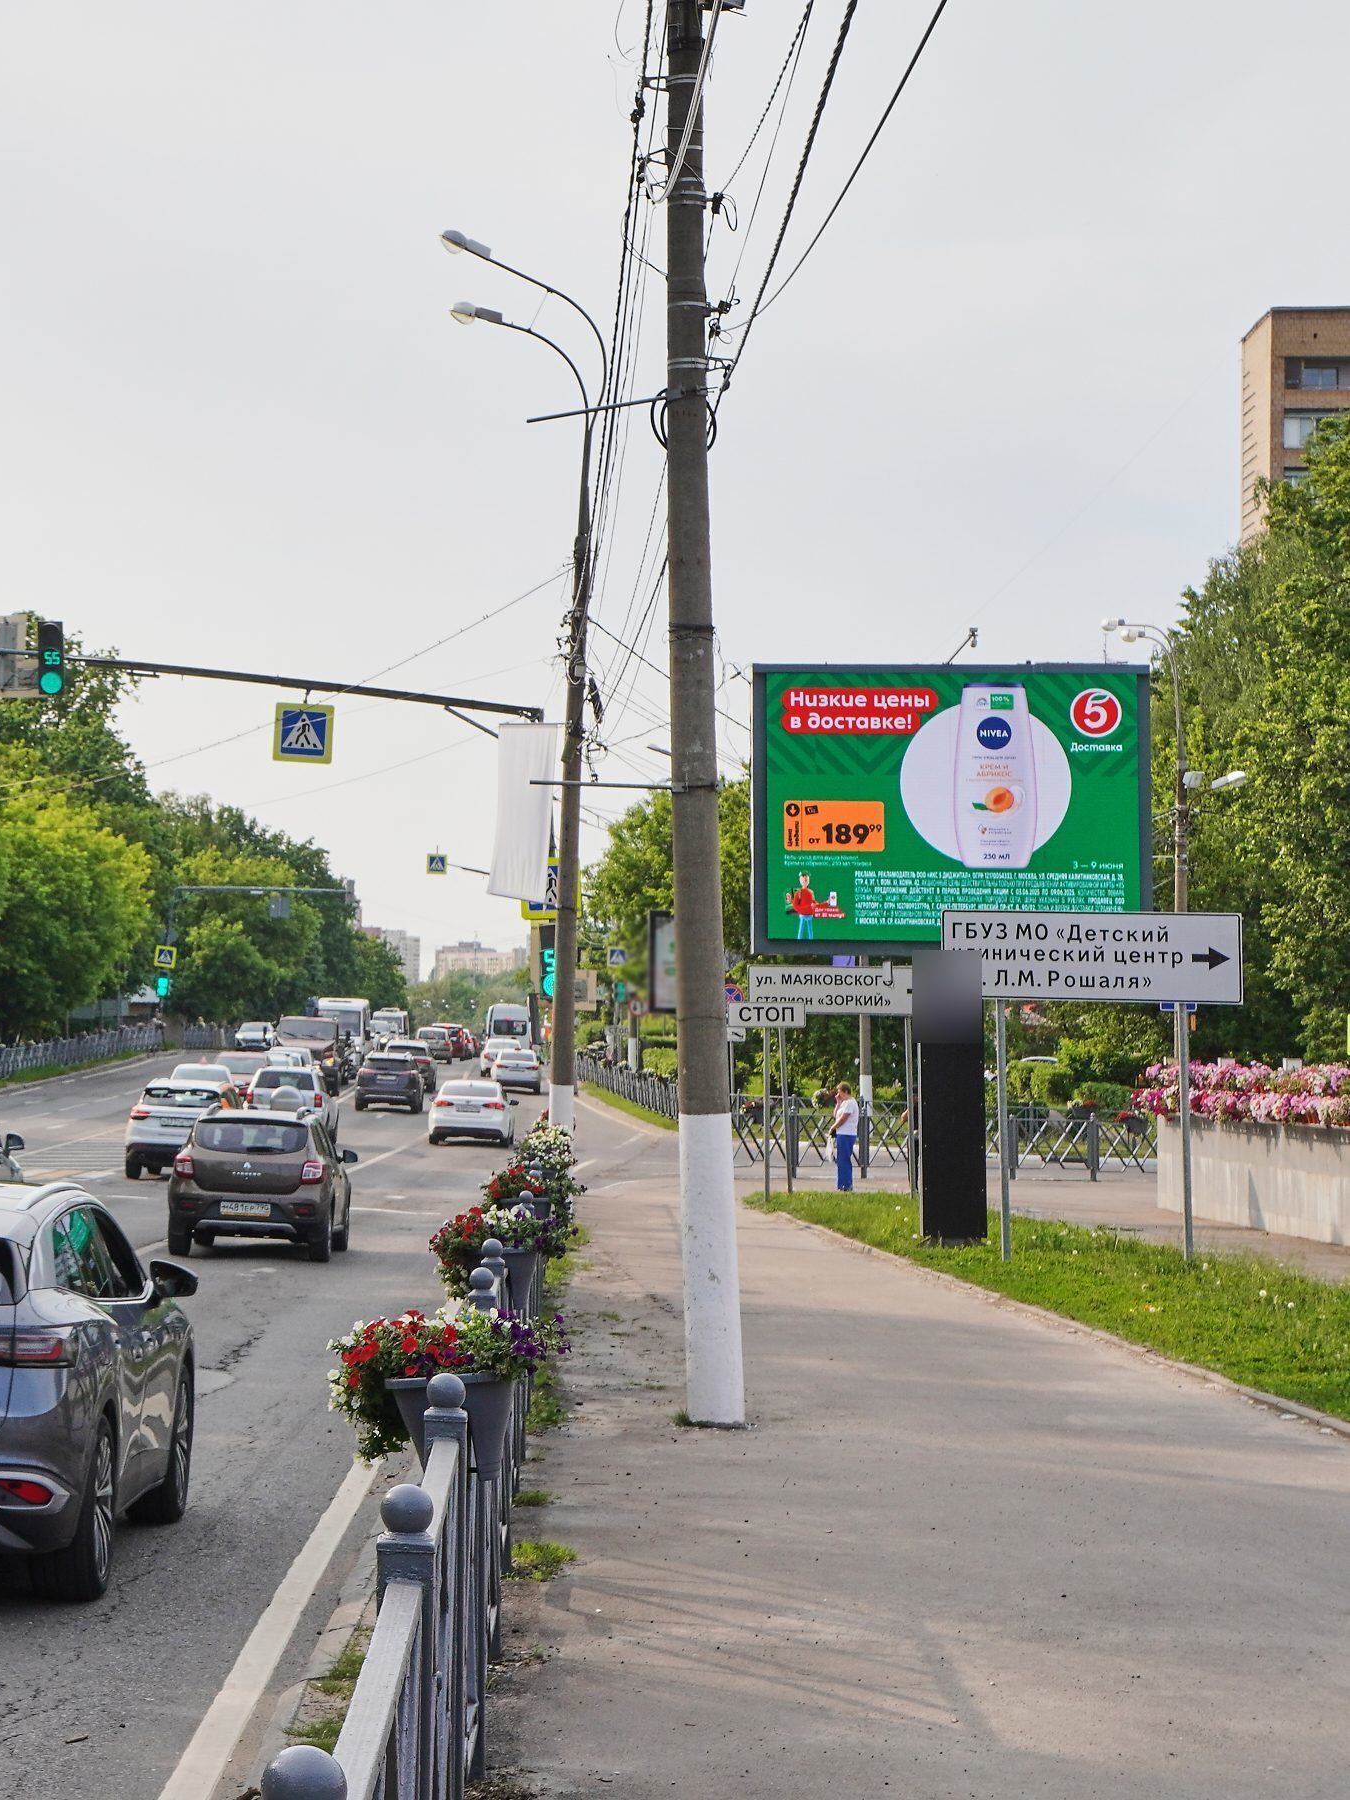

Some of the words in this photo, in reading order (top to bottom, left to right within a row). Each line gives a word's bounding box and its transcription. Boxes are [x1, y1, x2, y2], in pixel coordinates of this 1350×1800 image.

[43, 651, 61, 665] 55
[790, 691, 867, 708] Низкие
[873, 694, 930, 709] цены
[790, 716, 802, 729] в
[807, 712, 912, 730] доставке!
[979, 729, 1009, 738] NIVEA
[1070, 742, 1123, 753] Доставка
[1073, 861, 1078, 870] 3
[1091, 861, 1097, 870] 9
[951, 922, 1008, 940] ГБУЗ
[1015, 923, 1049, 940] МО
[1056, 924, 1170, 943] «Детский
[952, 945, 1106, 962] инический
[1114, 951, 1184, 968] центр
[755, 975, 777, 988] ул.
[994, 969, 1042, 987] Л.М.
[1047, 970, 1153, 989] Рошаля»
[818, 992, 891, 1007] «ЗОРКИЙ»
[738, 1006, 795, 1022] СТОП
